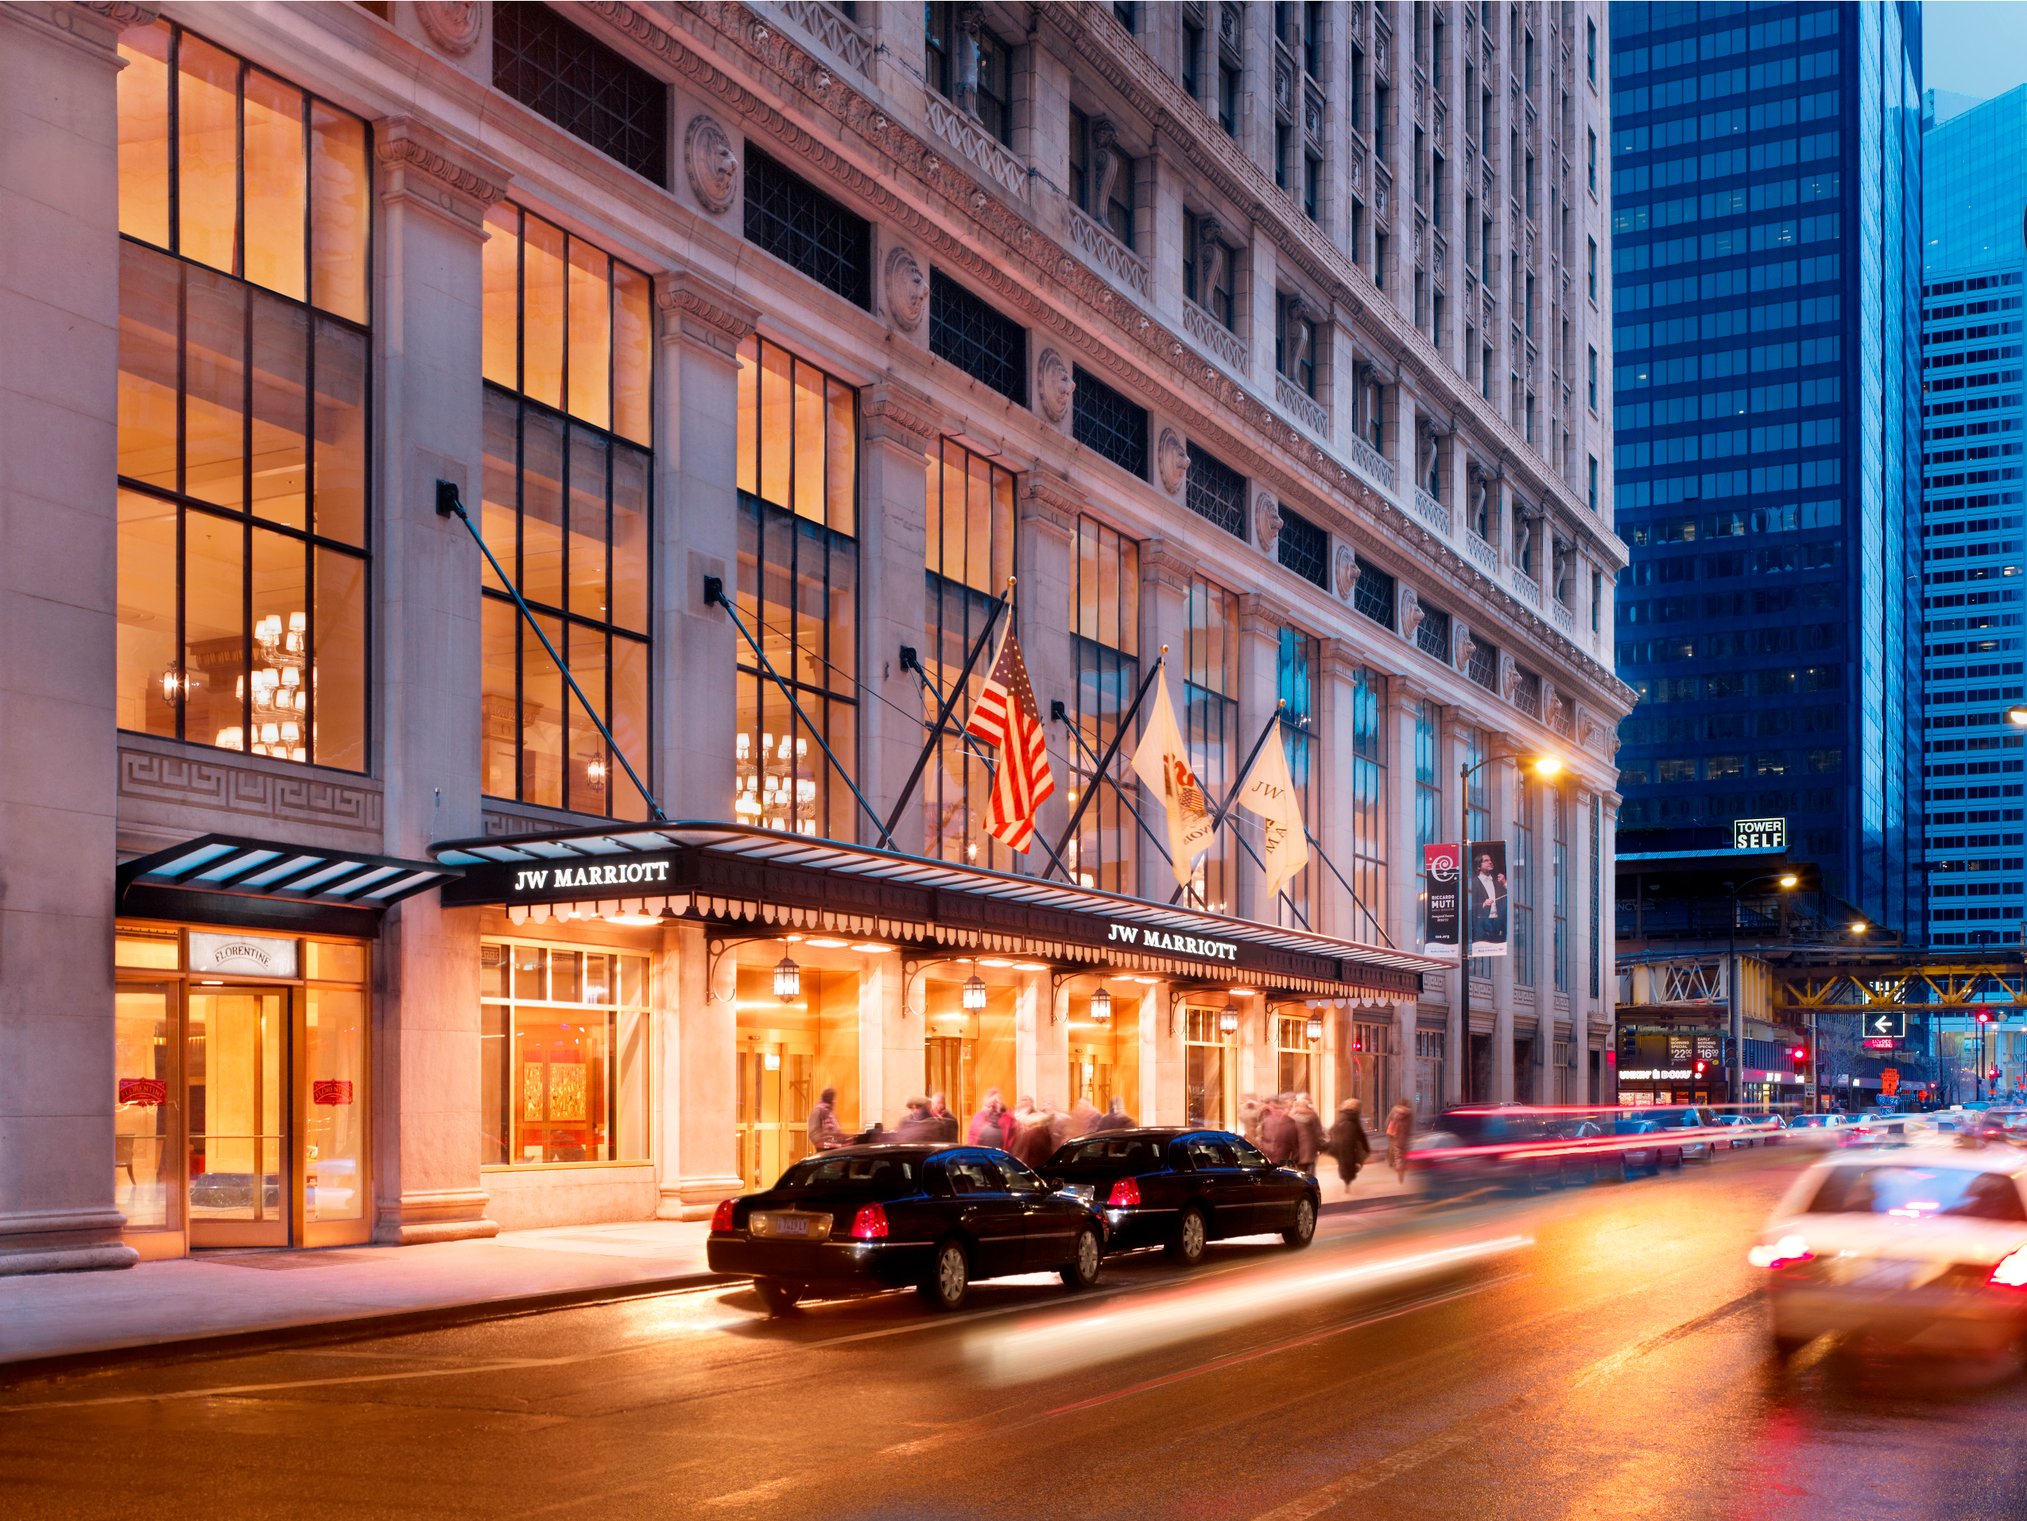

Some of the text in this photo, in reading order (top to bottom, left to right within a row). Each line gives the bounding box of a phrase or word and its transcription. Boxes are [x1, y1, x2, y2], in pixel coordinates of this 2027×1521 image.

[1252, 781, 1285, 800] JW
[1737, 821, 1782, 833] TOWER
[1737, 833, 1782, 849] SELF
[515, 861, 670, 890] JW MARRIOTT
[1431, 900, 1455, 909] MUTI
[1108, 924, 1238, 960] JW MARRIOTT
[215, 945, 271, 968] FLORENTINE
[1660, 1070, 1702, 1080] DONUS
